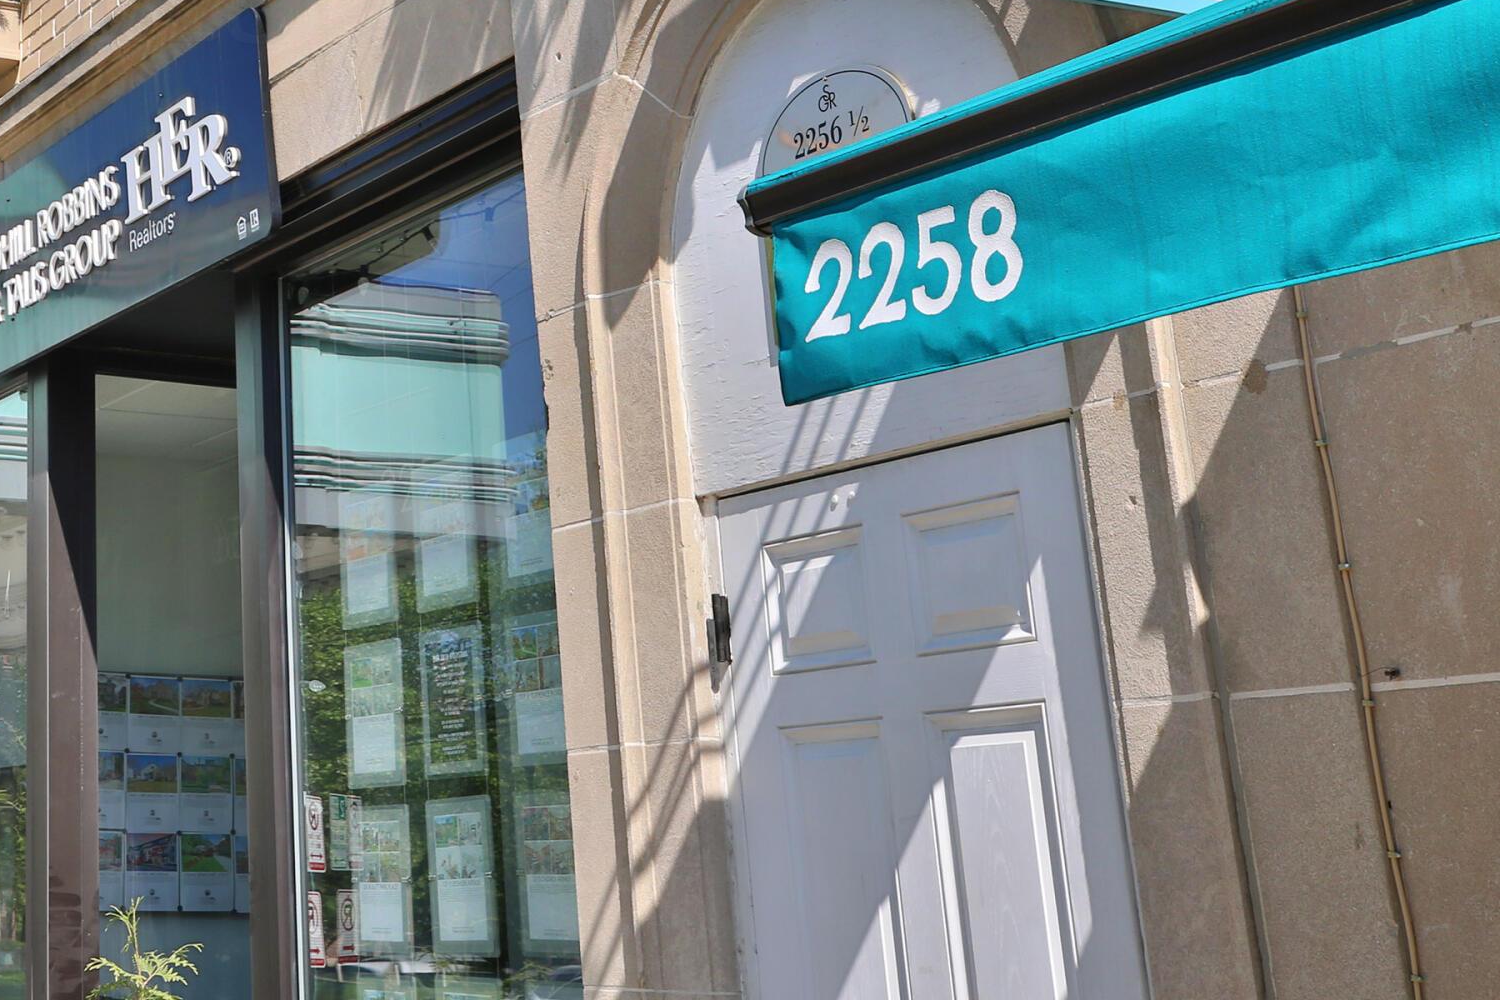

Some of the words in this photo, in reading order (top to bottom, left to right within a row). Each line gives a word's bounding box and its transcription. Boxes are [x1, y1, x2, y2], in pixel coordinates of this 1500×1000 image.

[794, 116, 843, 160] 2256
[36, 165, 122, 248] ROBBINS
[49, 218, 124, 291] GROUP
[804, 189, 1023, 343] 2258
